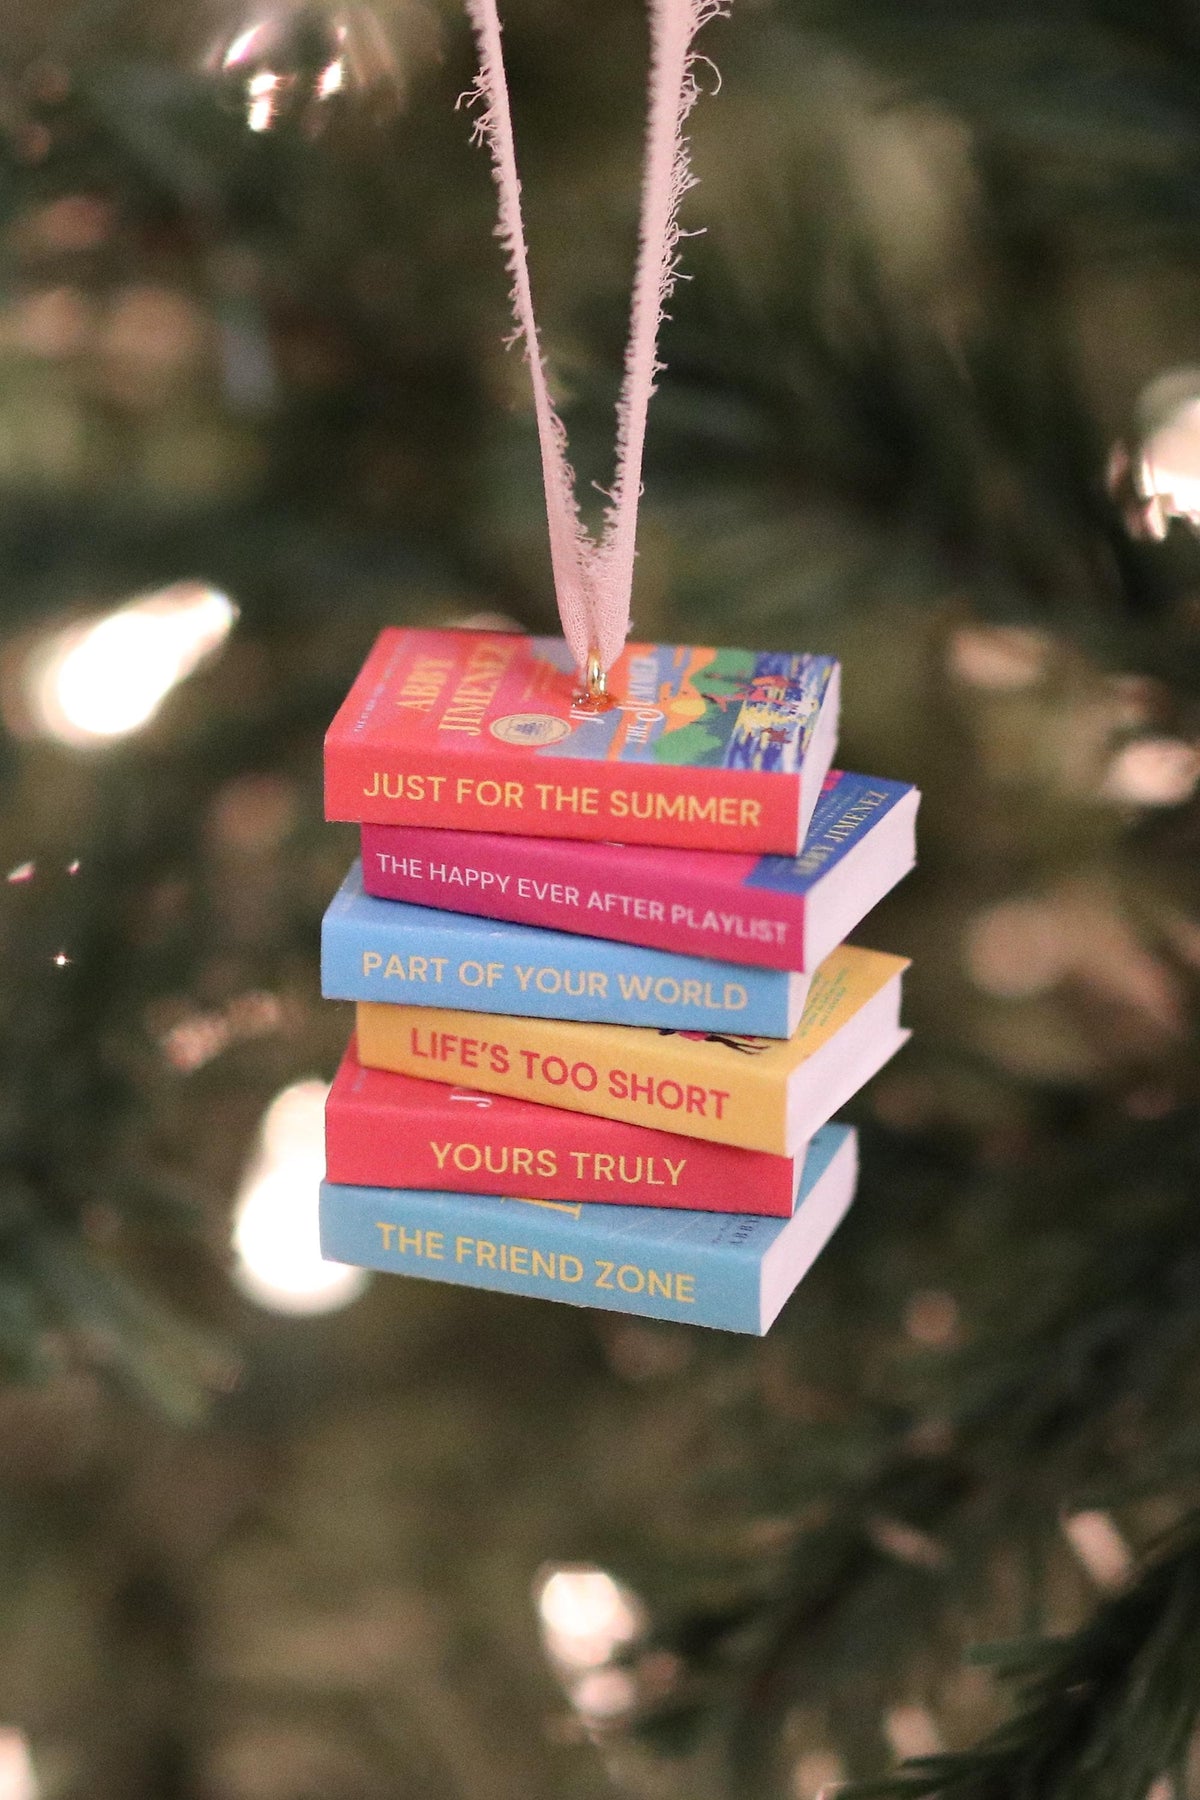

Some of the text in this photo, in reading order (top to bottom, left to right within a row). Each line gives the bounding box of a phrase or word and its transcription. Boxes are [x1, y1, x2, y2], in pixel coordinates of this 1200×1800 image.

[363, 772, 763, 828] JUST FOR THE SUMMER
[376, 853, 789, 944] THE HAPPY EVER AFTER PLAYLIST
[363, 952, 749, 1011] PART OF YOUR WORLD
[521, 1050, 598, 1092] TOO
[608, 1068, 730, 1120] SHORT
[429, 1141, 687, 1186] YOURS TRULY
[376, 1222, 697, 1303] THE FRIEND ZONE
